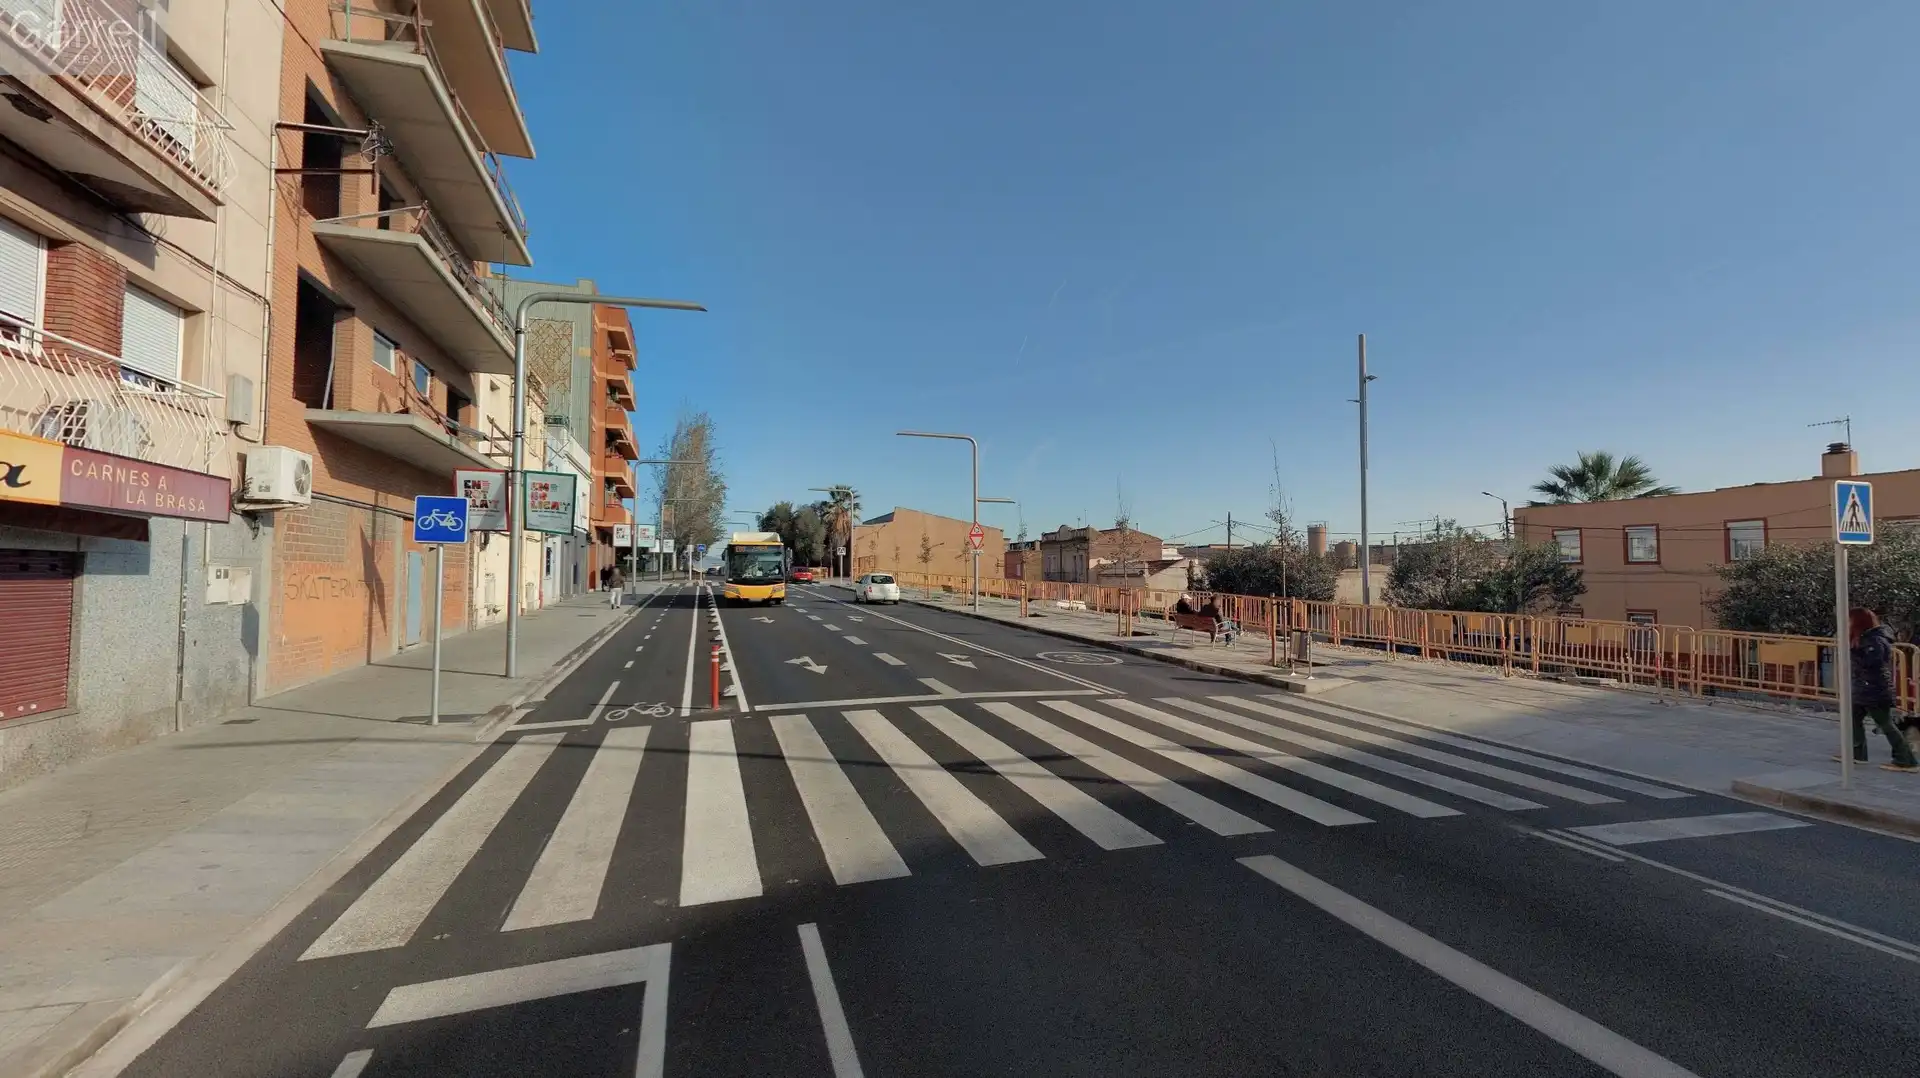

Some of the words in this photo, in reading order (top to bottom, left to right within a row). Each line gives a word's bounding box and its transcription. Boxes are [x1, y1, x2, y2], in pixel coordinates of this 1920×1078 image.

[70, 458, 151, 486] CARNES
[158, 475, 169, 491] A
[125, 489, 147, 506] LA
[155, 492, 207, 513] BRASA
